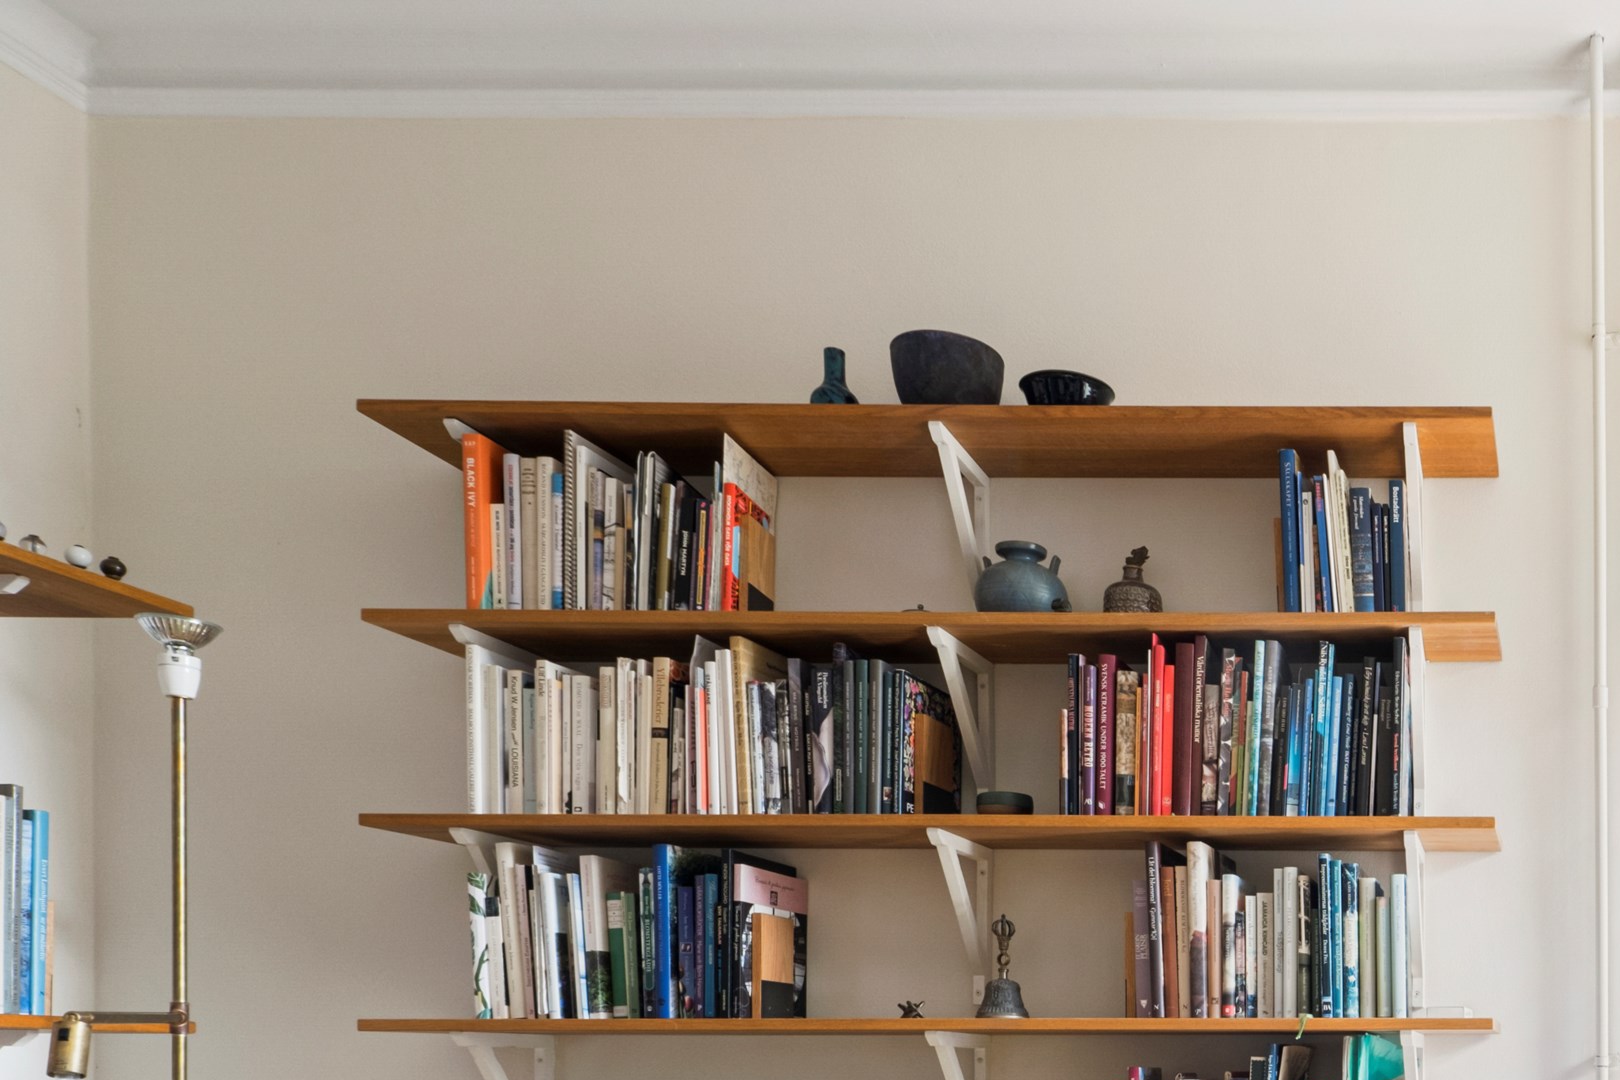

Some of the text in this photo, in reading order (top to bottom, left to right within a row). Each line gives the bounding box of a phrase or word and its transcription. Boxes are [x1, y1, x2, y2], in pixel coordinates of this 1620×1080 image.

[466, 457, 476, 488] BLACK
[467, 491, 476, 508] IVY
[1392, 486, 1400, 523] Bostadsrätt
[1100, 663, 1108, 690] SVENSK
[1195, 656, 1204, 678] Vårda
[511, 676, 519, 695] Knud
[655, 667, 666, 724] Yllebroderier
[511, 705, 519, 731] Jensen
[1084, 705, 1094, 767] MODERN RETRO
[511, 747, 519, 788] LOUISIANA
